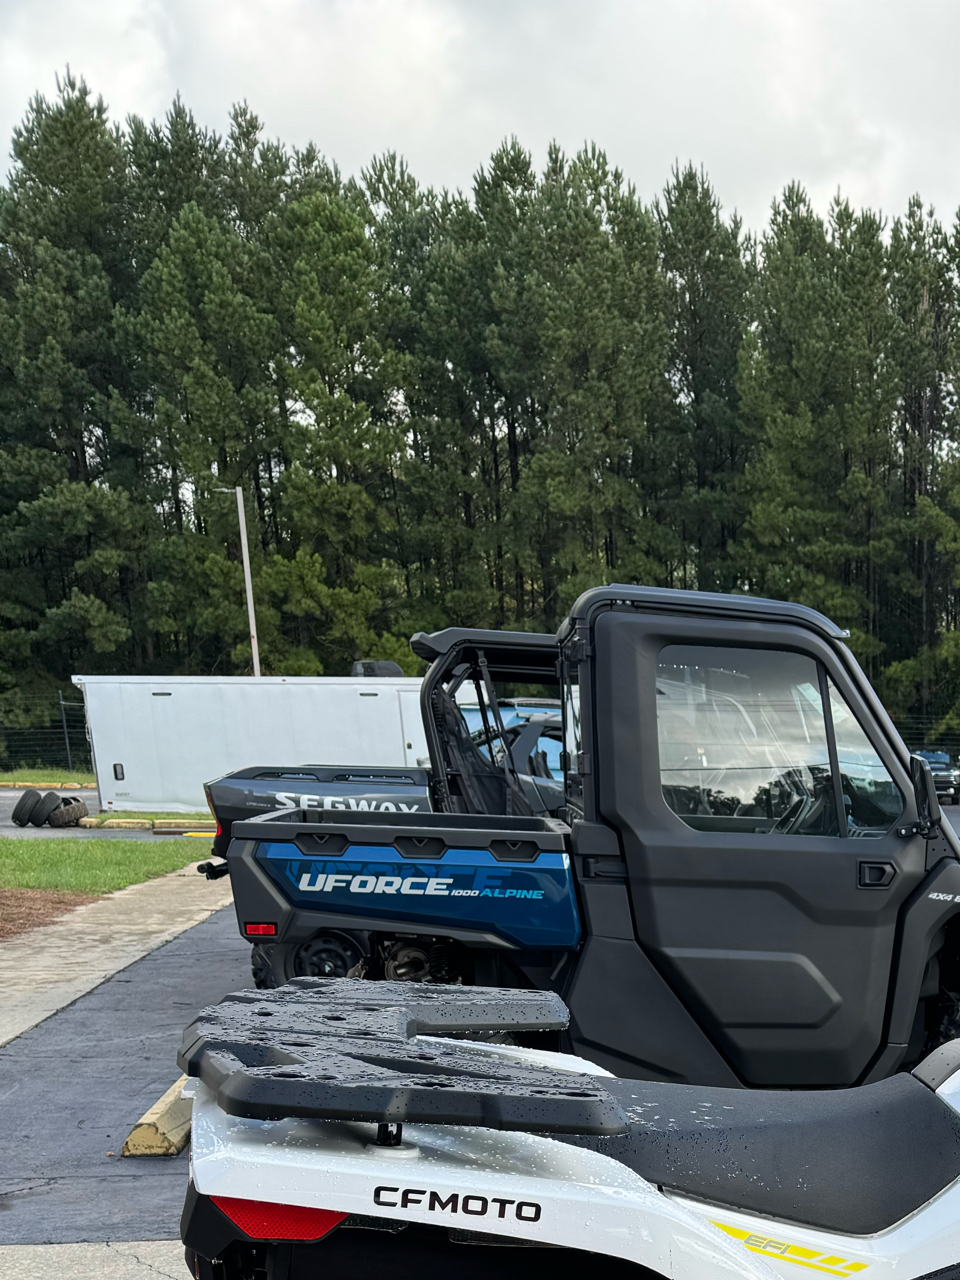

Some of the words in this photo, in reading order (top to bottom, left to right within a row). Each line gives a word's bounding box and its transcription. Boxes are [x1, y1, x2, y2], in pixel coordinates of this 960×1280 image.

[299, 873, 454, 896] UFORCE
[451, 889, 480, 897] 1000
[480, 888, 545, 899] ALPINE
[928, 891, 954, 901] 4X4
[373, 1185, 542, 1222] CFMOTO
[743, 1234, 791, 1255] EFI
